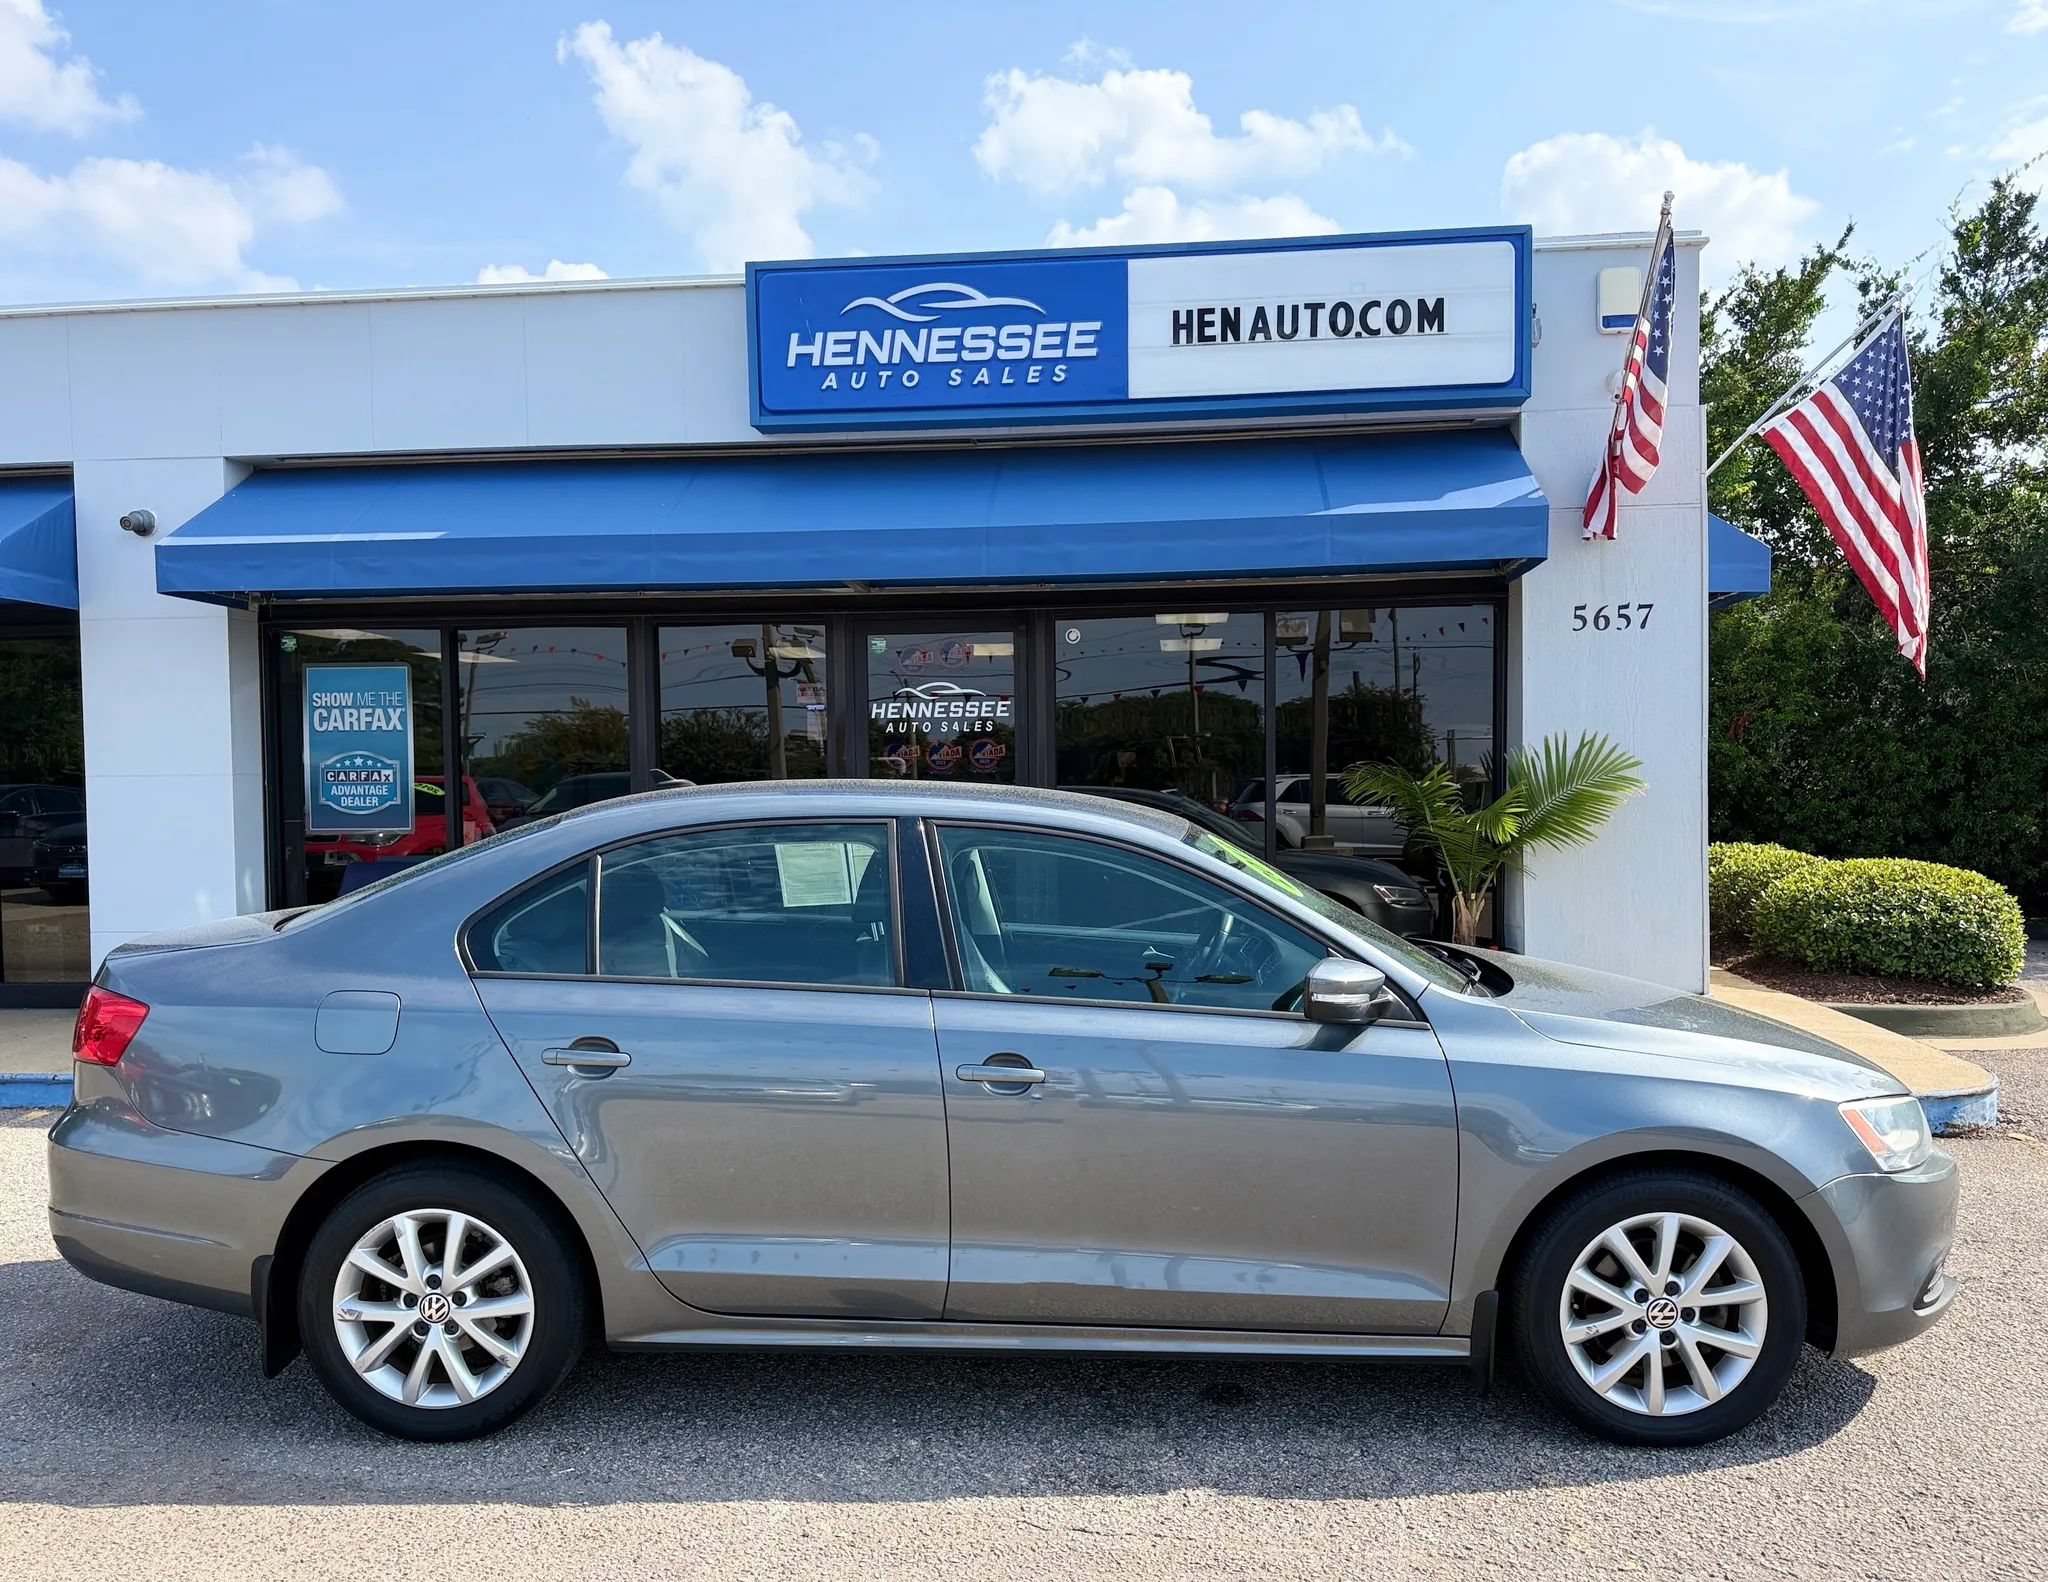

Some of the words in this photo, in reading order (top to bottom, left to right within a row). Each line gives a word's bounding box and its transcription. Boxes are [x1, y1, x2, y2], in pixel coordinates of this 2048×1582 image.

[1171, 297, 1445, 345] HENAUTO.COM
[786, 321, 1103, 368] HENNESSEE
[820, 369, 921, 390] AUTO
[947, 364, 1068, 386] SALES
[1572, 602, 1654, 632] 5657
[312, 692, 353, 707] SHOW
[356, 691, 376, 706] ME
[378, 691, 402, 706] THE
[871, 701, 1012, 719] HENNESSEE
[313, 707, 404, 732] CARFAX
[885, 721, 932, 733] AUTO
[940, 720, 994, 732] SALES
[327, 771, 391, 782] CARFAX
[331, 785, 389, 796] ADVANTAGE
[341, 796, 379, 807] DEALER
